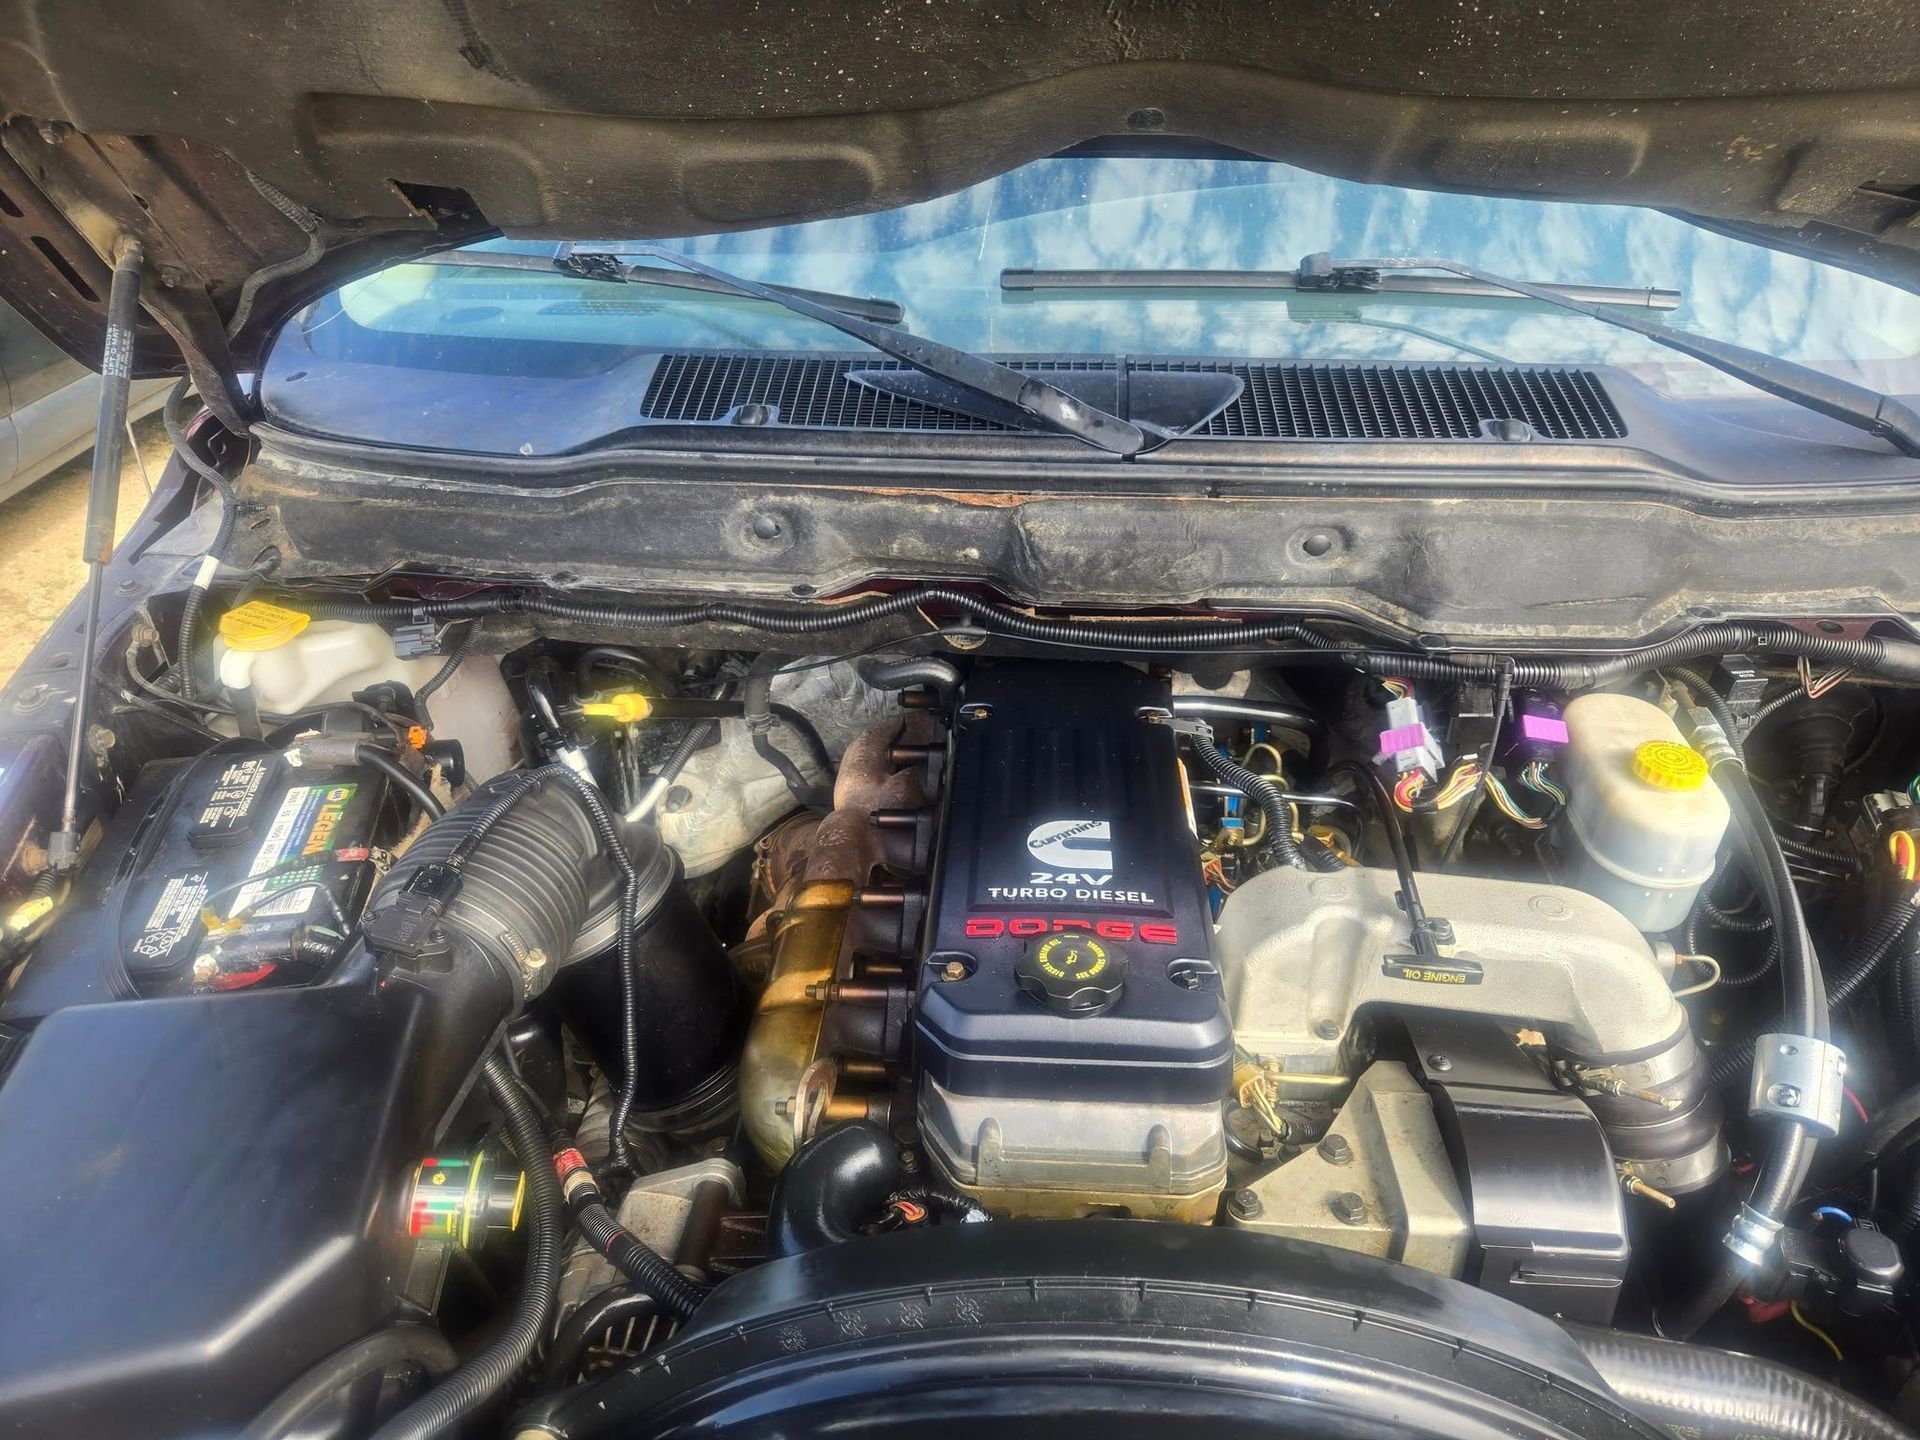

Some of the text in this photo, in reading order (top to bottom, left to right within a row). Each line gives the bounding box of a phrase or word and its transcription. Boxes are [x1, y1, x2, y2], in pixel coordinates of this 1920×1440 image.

[302, 804, 341, 855] LEGEN
[1029, 820, 1102, 849] Cummins
[1030, 873, 1113, 886] 24V
[988, 888, 1155, 904] TURBO DIESEL
[1039, 938, 1065, 978] DIESEL ENGINE OIL
[1402, 967, 1466, 983] ENGINE OIL
